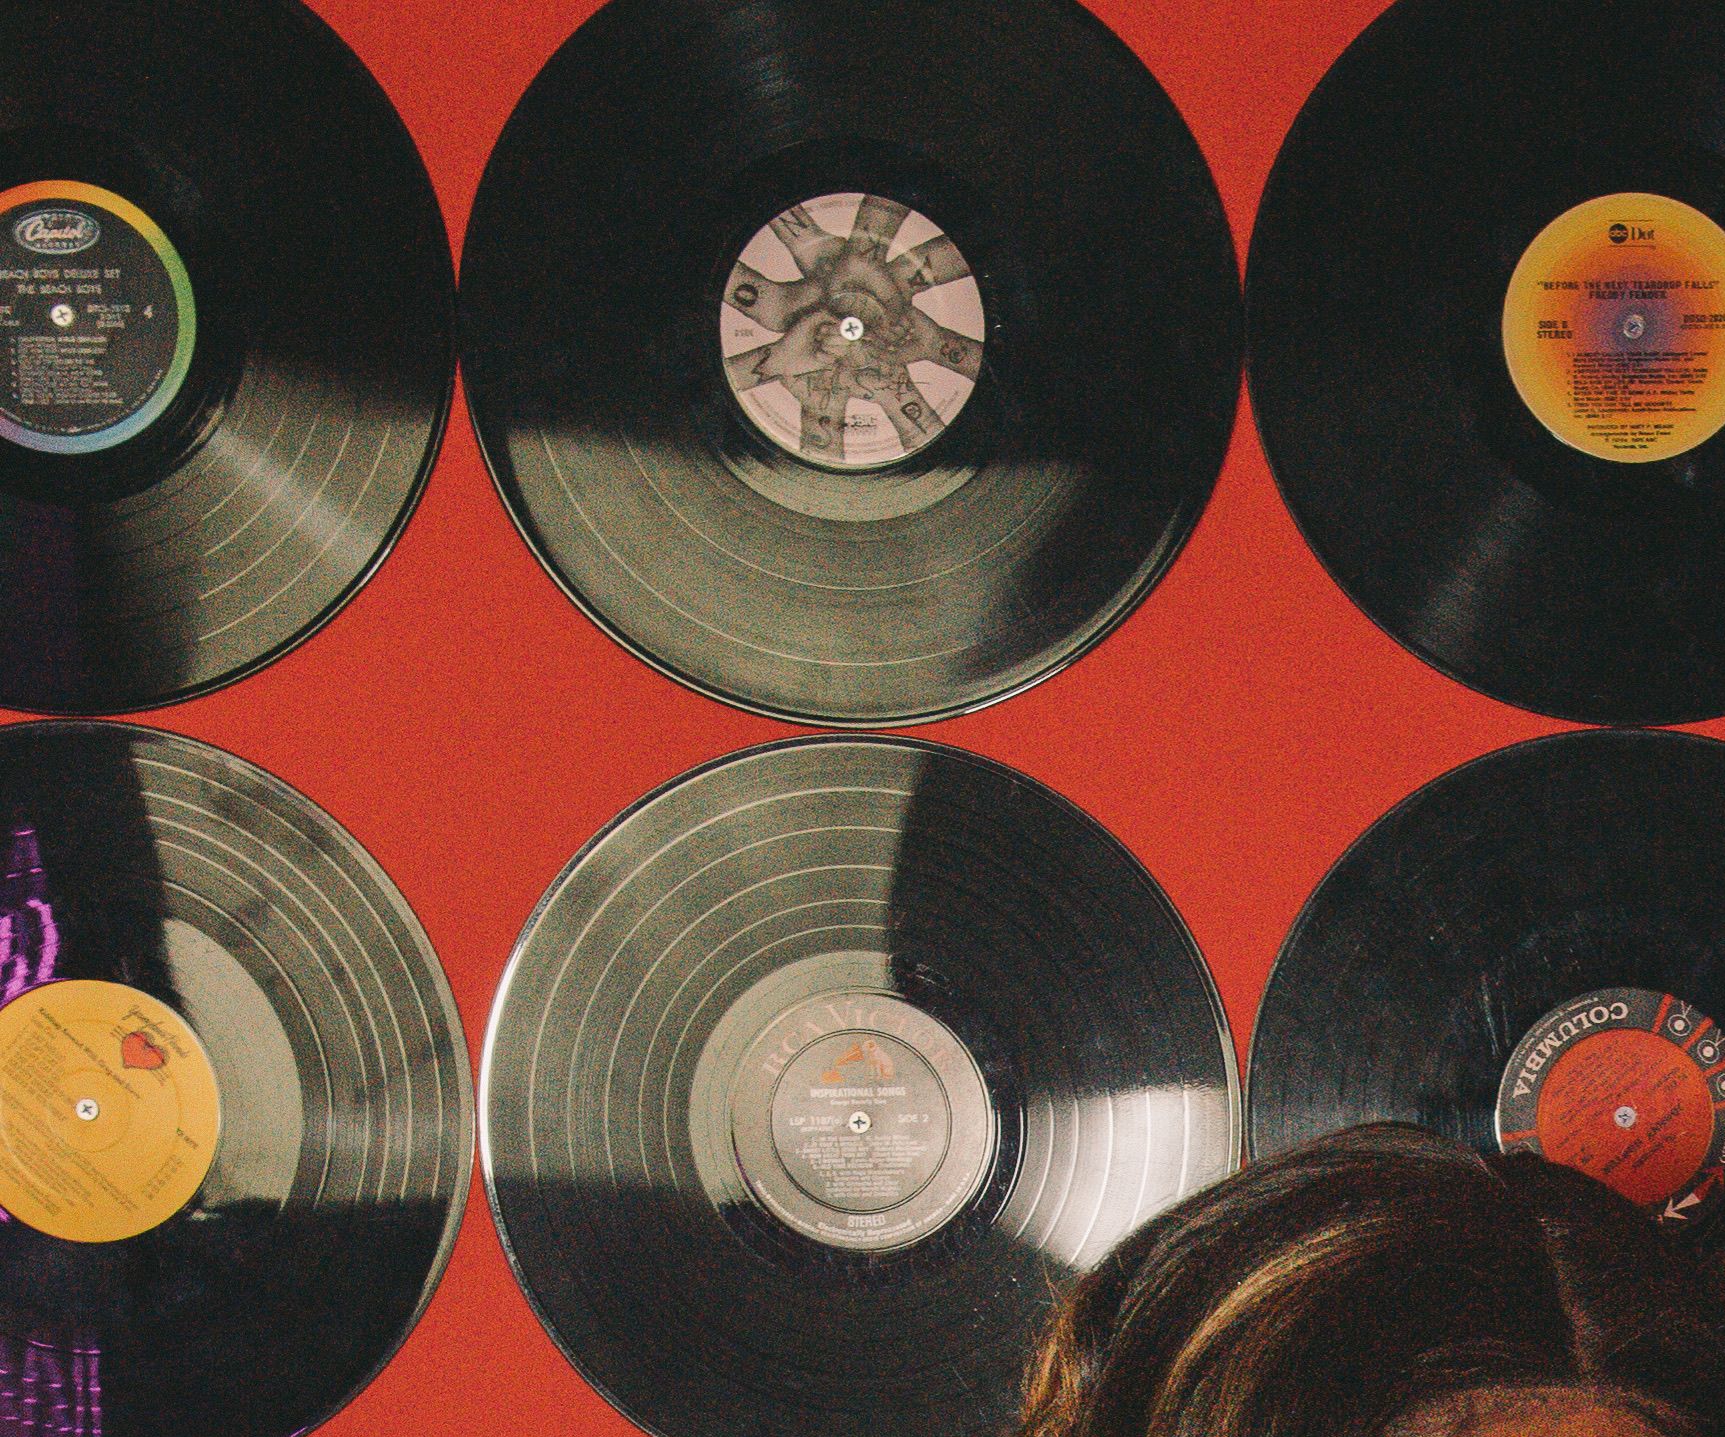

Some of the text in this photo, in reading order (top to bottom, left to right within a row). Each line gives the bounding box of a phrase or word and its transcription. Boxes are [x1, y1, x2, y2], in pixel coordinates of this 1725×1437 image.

[1536, 330, 1574, 340] STEREO
[1512, 1001, 1629, 1099] COLUMBIA
[847, 1214, 886, 1228] STEREO
